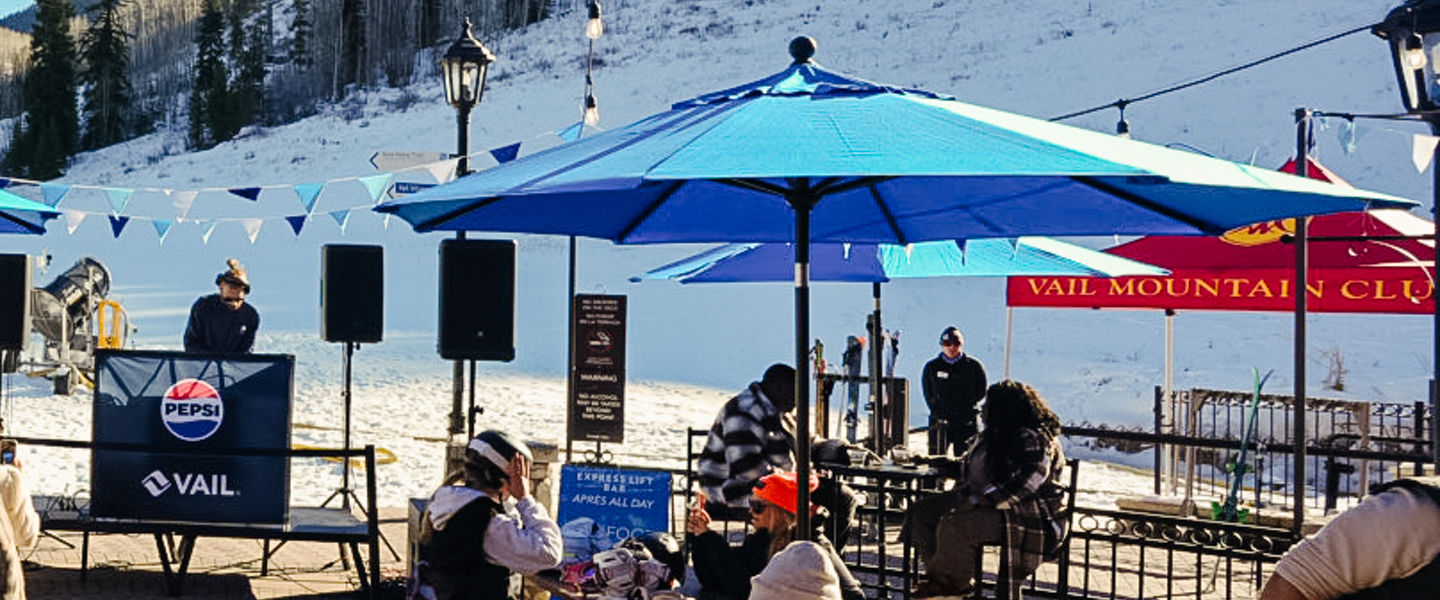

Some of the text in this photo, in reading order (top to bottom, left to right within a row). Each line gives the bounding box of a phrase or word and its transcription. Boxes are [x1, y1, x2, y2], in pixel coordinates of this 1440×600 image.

[1027, 277, 1435, 300] VAIL MOUNTAIN CLU
[164, 403, 220, 417] PEPSI
[172, 472, 235, 496] VAIL
[576, 472, 655, 486] EXPRESS LIFT
[603, 483, 627, 493] BAR
[607, 496, 628, 508] ALL
[630, 497, 655, 509] DAY
